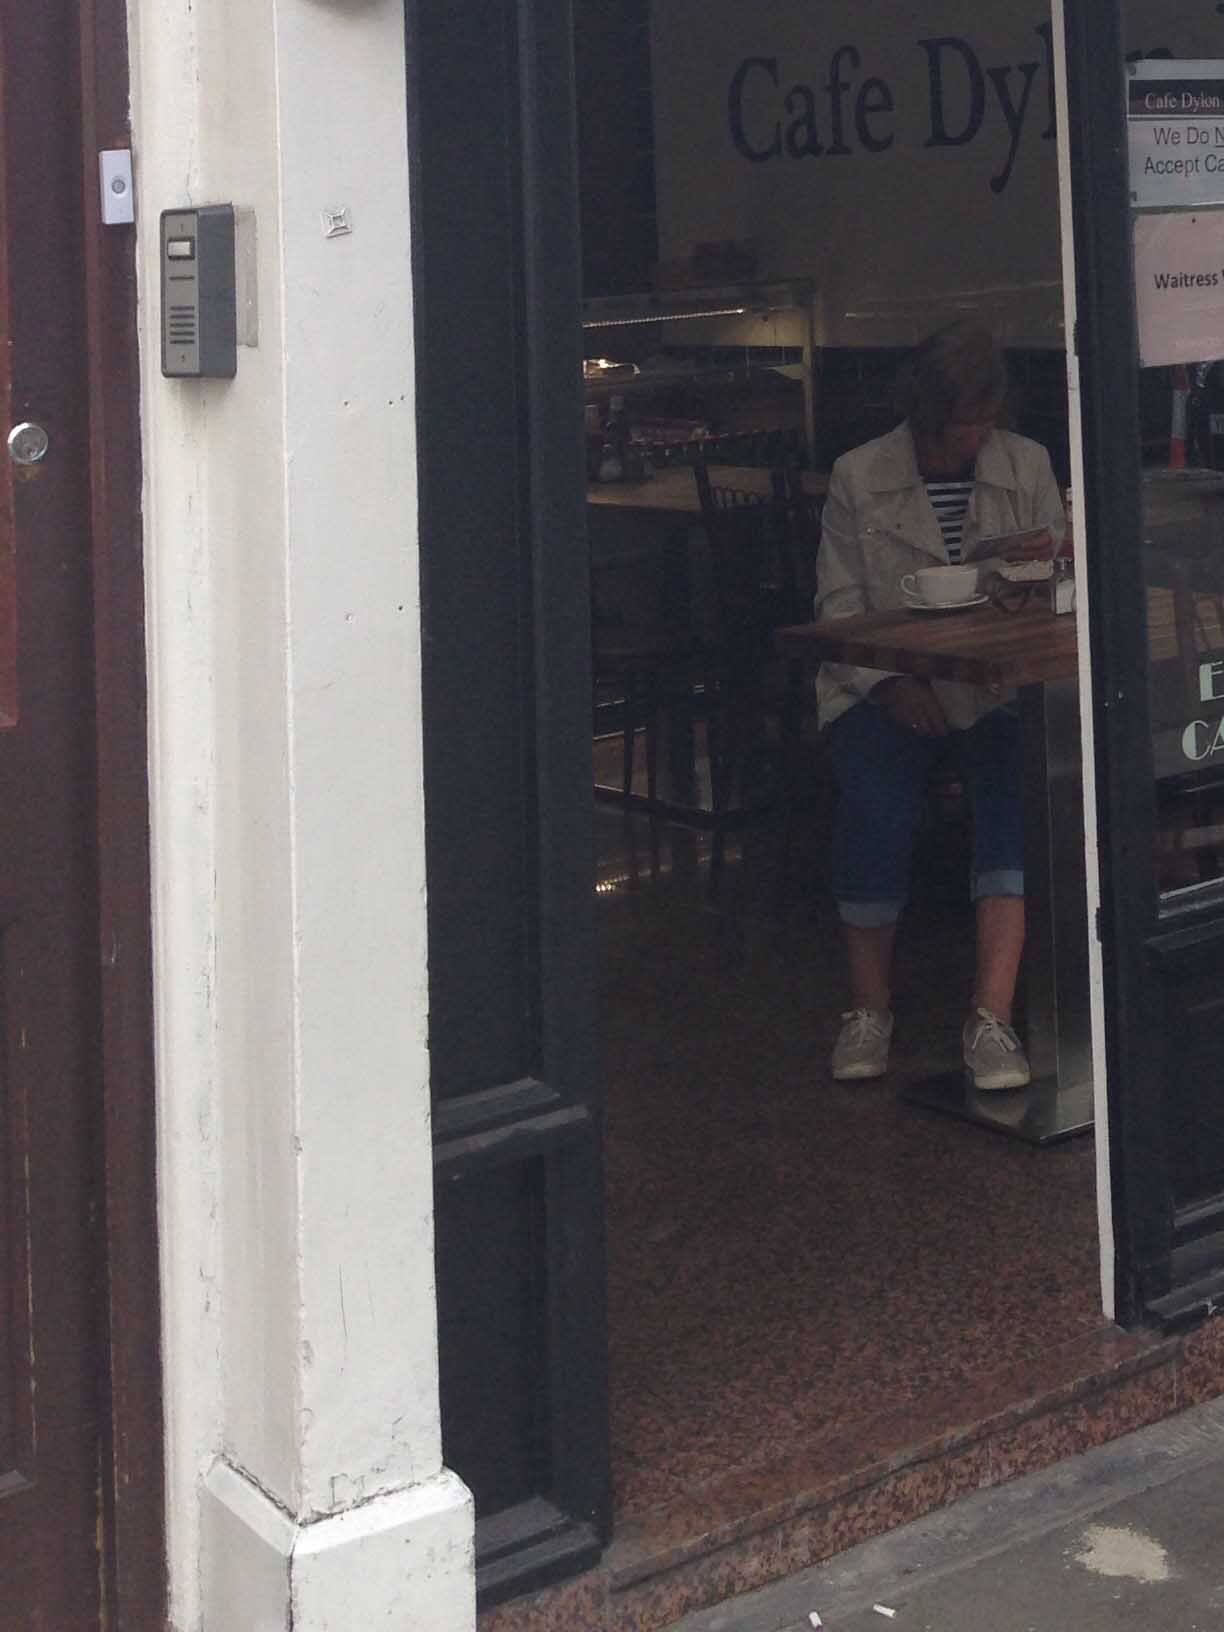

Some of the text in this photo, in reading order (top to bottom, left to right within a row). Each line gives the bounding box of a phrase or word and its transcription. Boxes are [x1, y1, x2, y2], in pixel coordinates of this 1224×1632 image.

[728, 44, 896, 163] Cafe
[1145, 91, 1177, 109] Cafe
[1153, 127, 1181, 145] We
[1186, 126, 1209, 145] Do
[1144, 155, 1200, 178] Accept
[1154, 268, 1218, 290] Waitress
